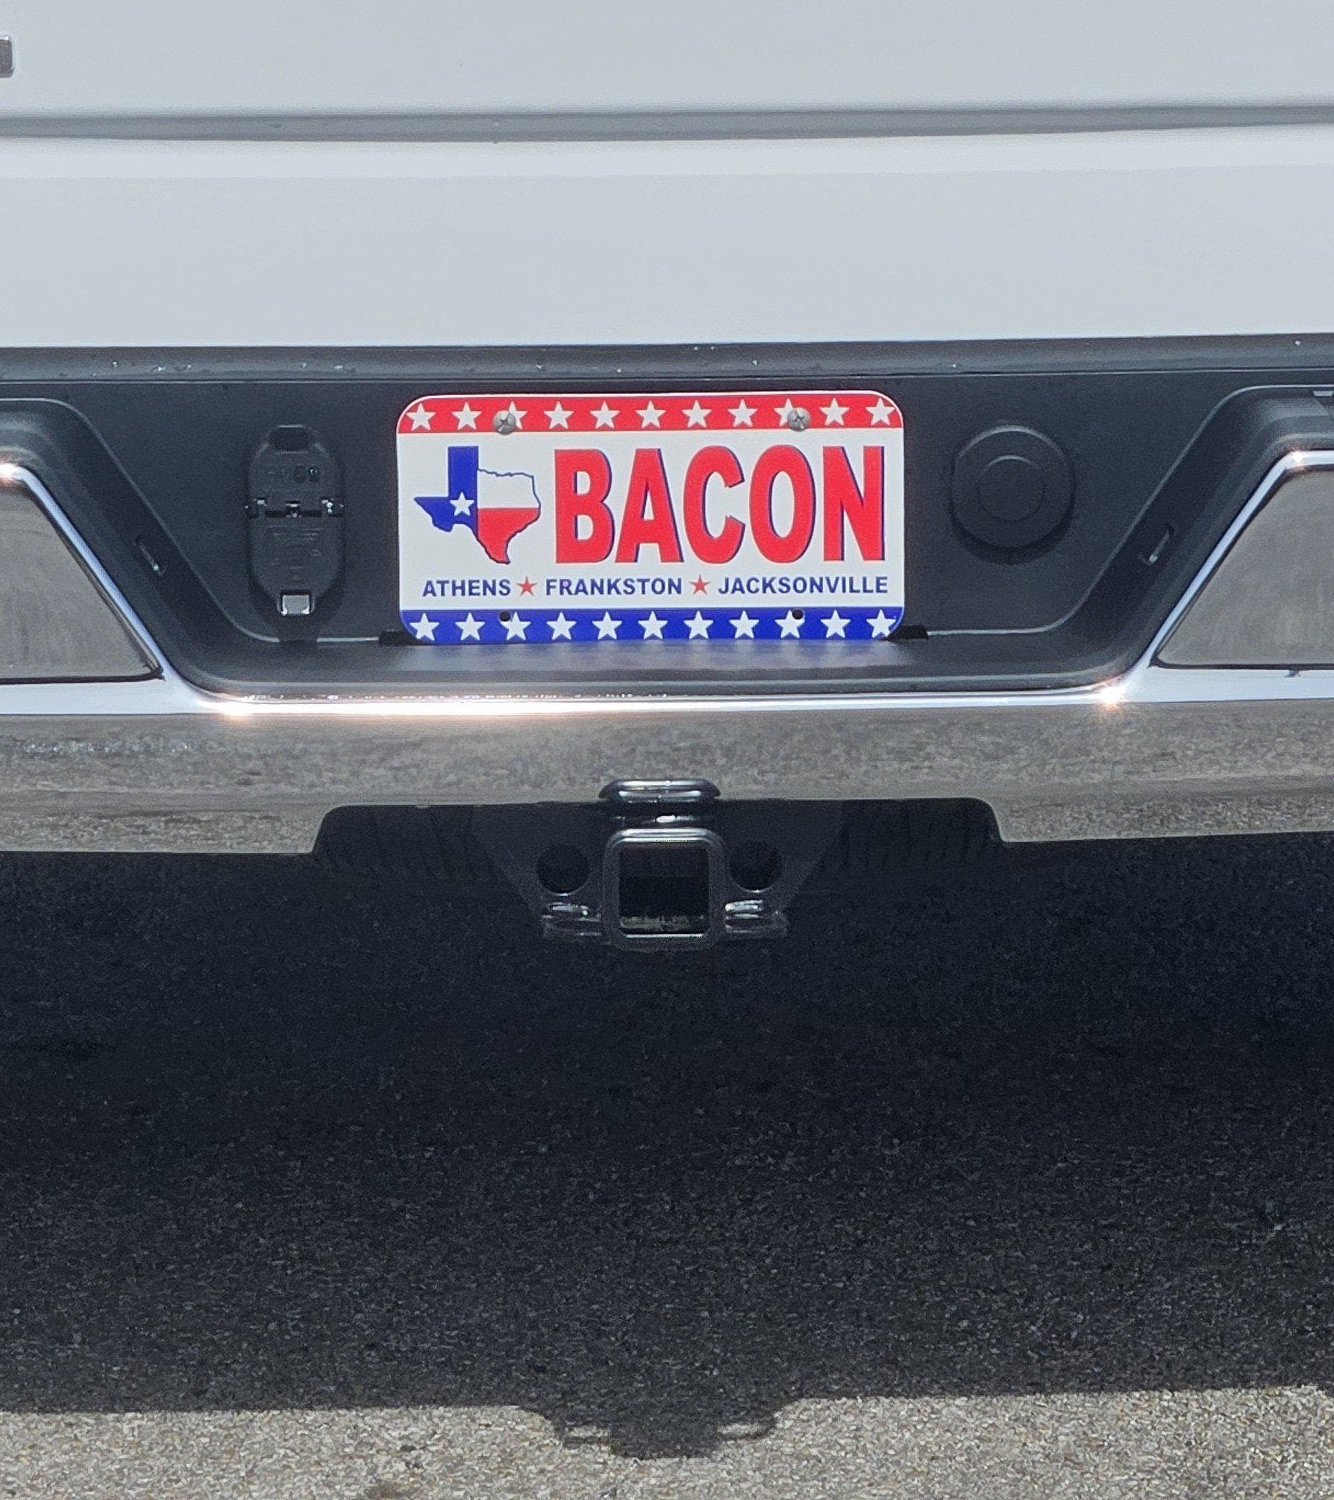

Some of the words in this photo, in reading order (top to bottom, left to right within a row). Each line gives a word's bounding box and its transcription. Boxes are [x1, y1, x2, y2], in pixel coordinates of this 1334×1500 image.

[554, 445, 886, 564] BACON
[422, 578, 511, 598] ATHENS
[545, 577, 682, 596] FRANKSTON
[717, 576, 888, 595] JACKSONVILLE
